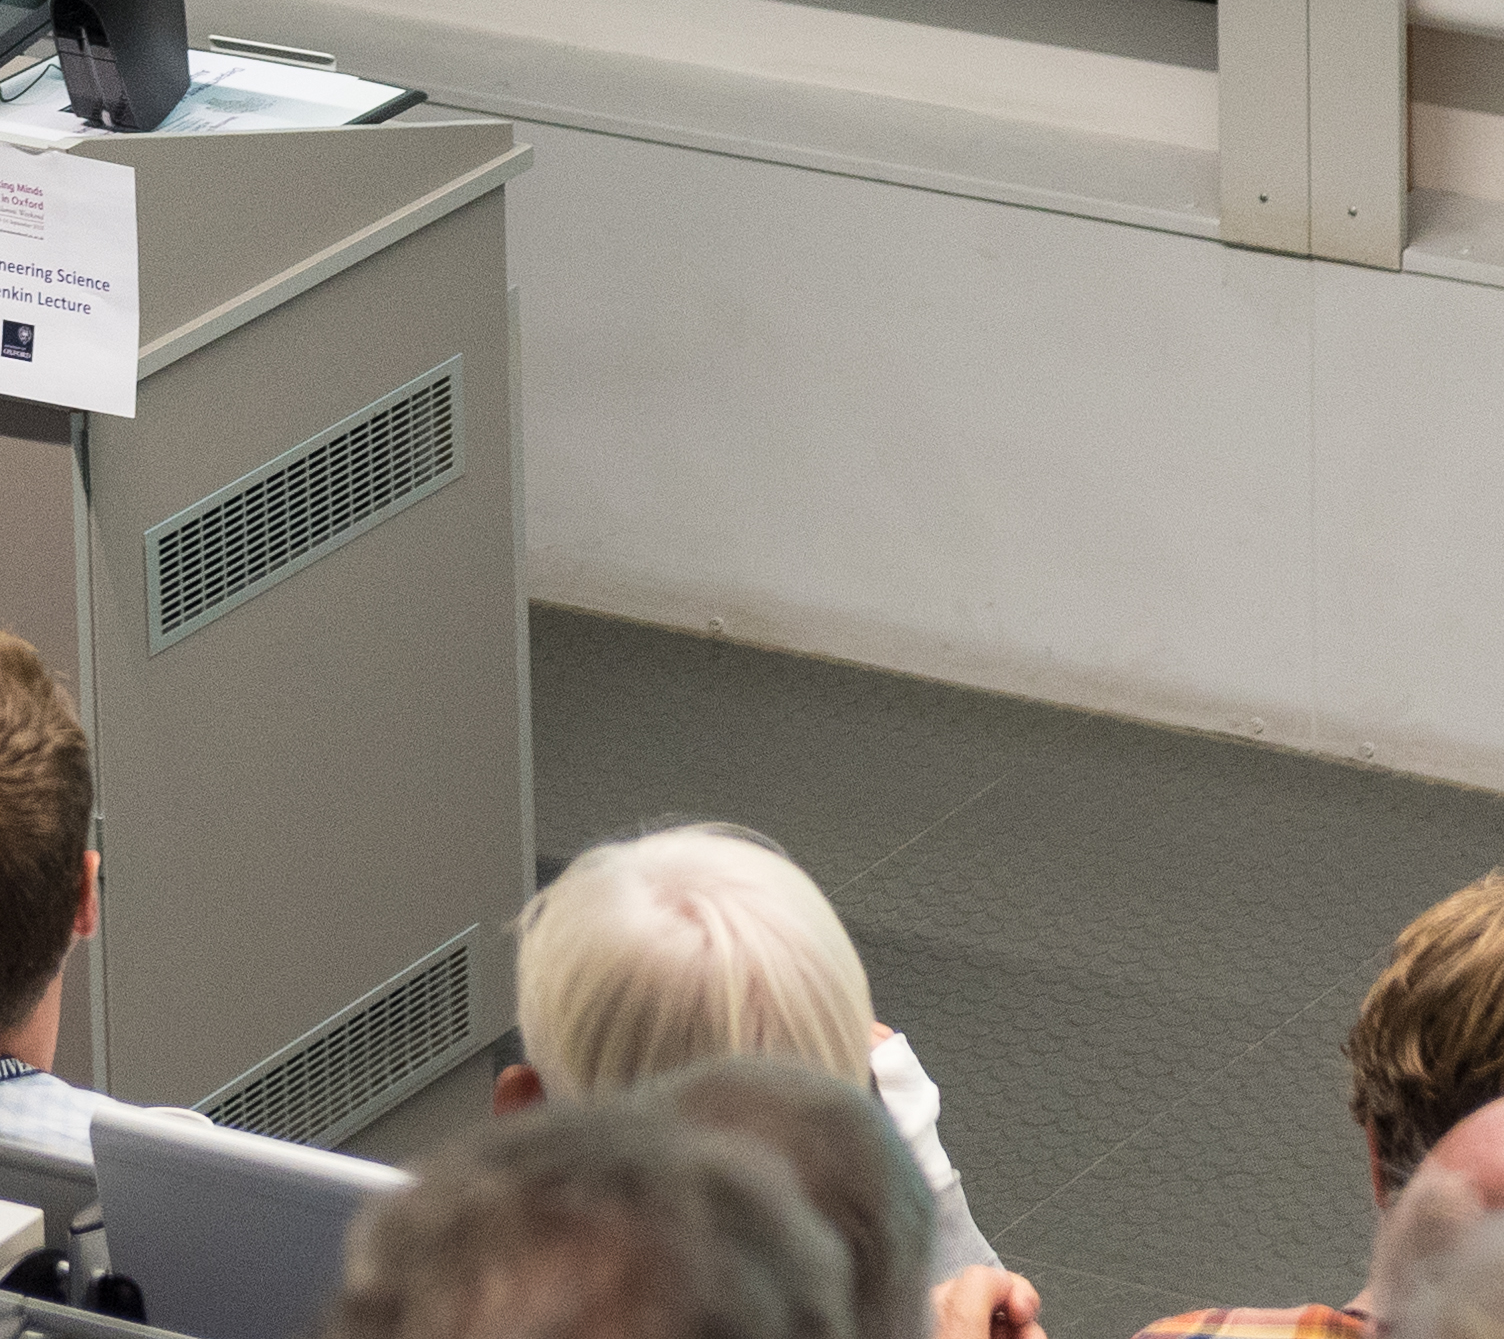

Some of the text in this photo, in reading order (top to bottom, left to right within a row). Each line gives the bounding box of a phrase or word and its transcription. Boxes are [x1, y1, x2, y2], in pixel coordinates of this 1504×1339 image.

[16, 184, 43, 197] Minds
[1, 193, 44, 210] in Oxford
[57, 269, 110, 292] Science
[38, 292, 92, 315] Lecture
